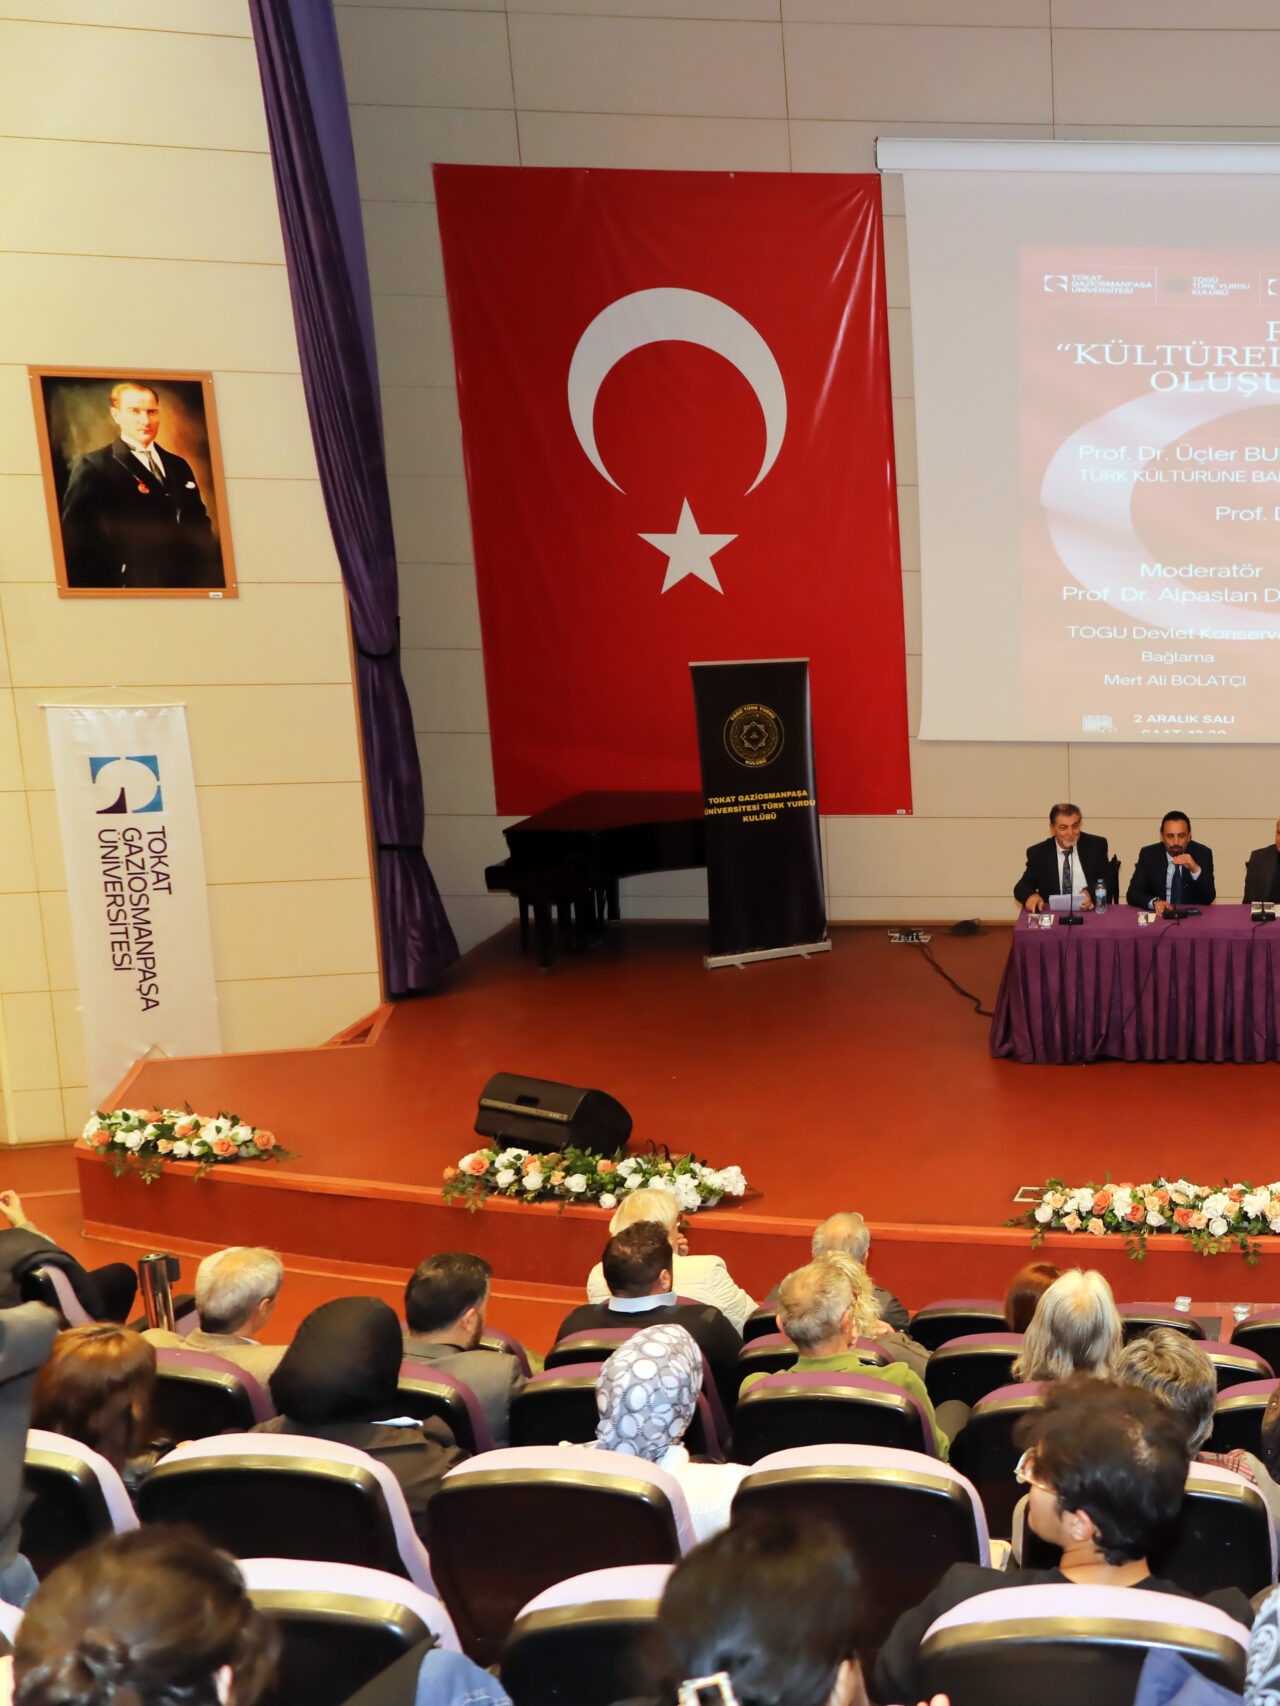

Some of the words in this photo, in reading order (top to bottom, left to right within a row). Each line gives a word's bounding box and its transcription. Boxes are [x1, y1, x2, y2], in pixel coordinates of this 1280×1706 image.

[1071, 274, 1103, 282] TOKAT
[1079, 444, 1131, 462] Prof.
[1138, 445, 1169, 462] Dr.
[1176, 443, 1238, 465] Üçler
[1079, 467, 1129, 483] TÜRK
[1132, 467, 1247, 484] KÜLTÜRÜNE
[1215, 506, 1267, 522] Prof.
[1139, 562, 1264, 578] Moderatör
[1158, 586, 1257, 605] Alpaslan
[1132, 626, 1195, 640] Devlet
[1141, 651, 1215, 665] Bağlama
[1104, 674, 1143, 687] Mert
[1146, 674, 1168, 687] Ali
[1170, 674, 1247, 689] BOLATÇI
[1133, 714, 1143, 724] 2
[1146, 714, 1198, 724] ARALIK
[1202, 715, 1235, 724] SALI
[708, 795, 736, 805] TOKAT
[738, 789, 808, 802] GAZİOSMANPAŞA
[704, 803, 760, 816] ÜNİVERSİTESİ
[761, 801, 784, 810] TÜRK
[787, 799, 816, 808] YURDU
[742, 811, 777, 822] KULÜBÜ
[146, 825, 173, 896] TOKAT
[97, 828, 135, 972] ÜNİVERSİTESİ
[122, 826, 160, 1012] GAZİOSMANPAŞA
